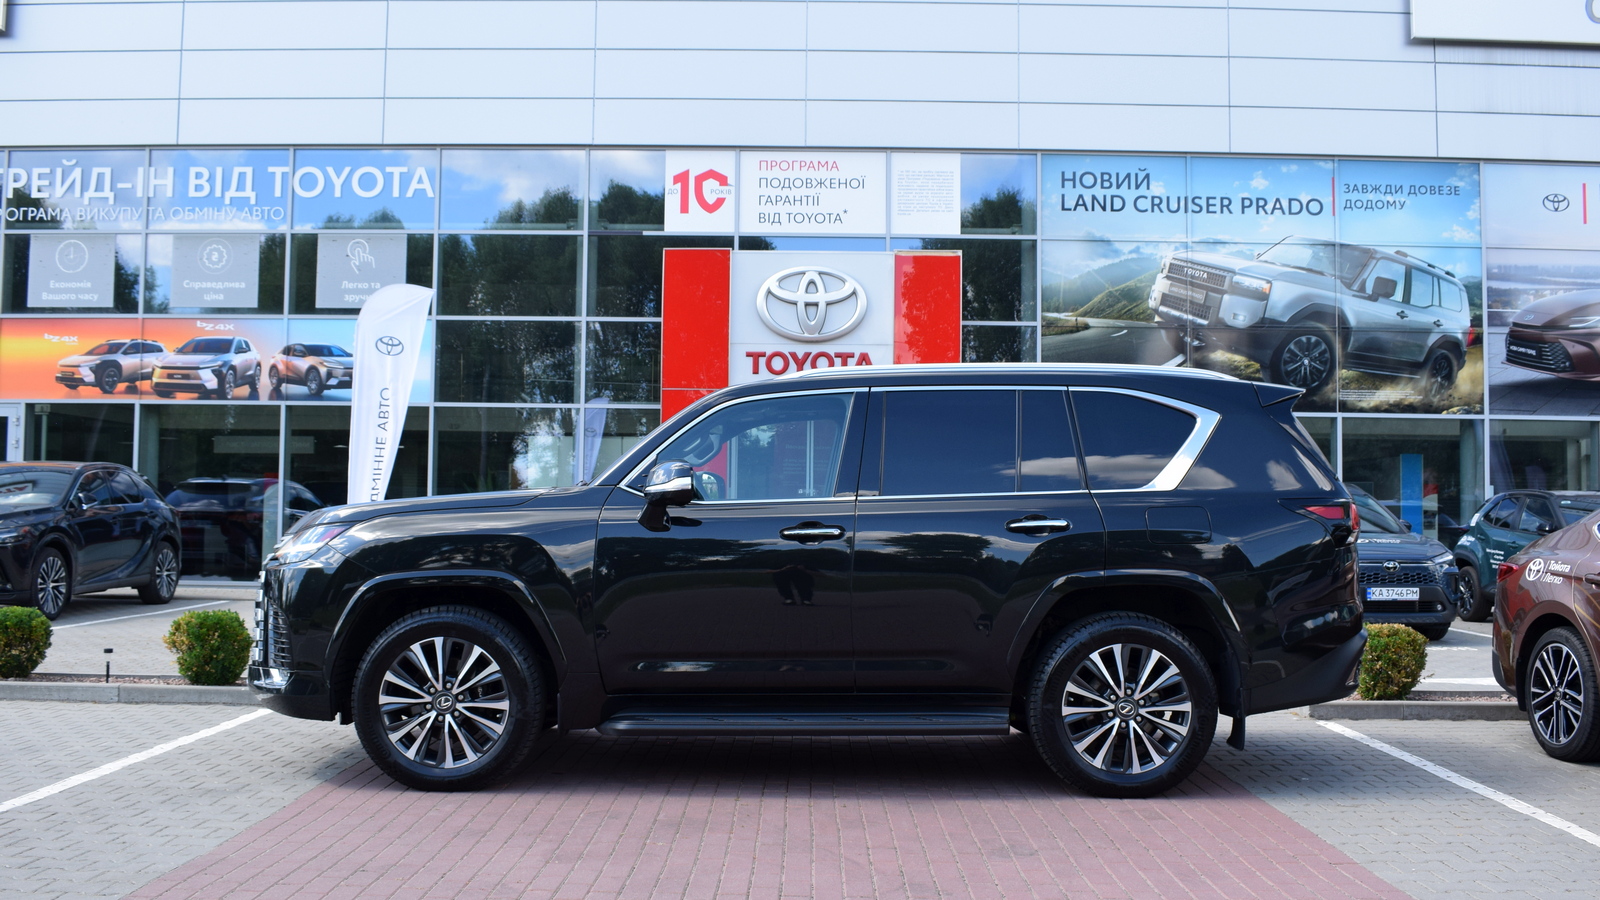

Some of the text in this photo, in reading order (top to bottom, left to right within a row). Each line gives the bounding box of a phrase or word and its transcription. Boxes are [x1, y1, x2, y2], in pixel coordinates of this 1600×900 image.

[758, 159, 840, 172] ПРОГРАМА
[0, 158, 435, 205] РЕЙД-ІН ВІД TOYOTA
[758, 175, 867, 191] ПОДОВЖЕНОЇ
[1060, 168, 1152, 191] НОВИЙ
[667, 188, 679, 196] ДО
[710, 188, 733, 196] РОКІВ
[1343, 183, 1461, 198] ЗАВЖДИ ДОВЕЗЕ
[758, 192, 821, 207] ГАРАНТІЇ
[1060, 195, 1325, 217] LAND CRUISER PRADO
[1343, 198, 1407, 212] ДОДОМУ
[0, 206, 286, 221] ОГРАМА ВИКУПУ ТА ОБМІНУ АВТО
[758, 211, 782, 226] ВІД
[1184, 268, 1207, 279] TOYOTA
[49, 279, 92, 289] Економія
[183, 279, 246, 290] Справедлива
[341, 280, 369, 289] Легко
[41, 291, 99, 302] Вашого часу
[203, 291, 225, 302] ціна
[745, 351, 873, 375] TOYOTA
[377, 387, 391, 432] АВТО
[1548, 560, 1572, 573] Тойота
[1542, 573, 1563, 585] Легко
[1371, 588, 1418, 598] KA 3746 PM
